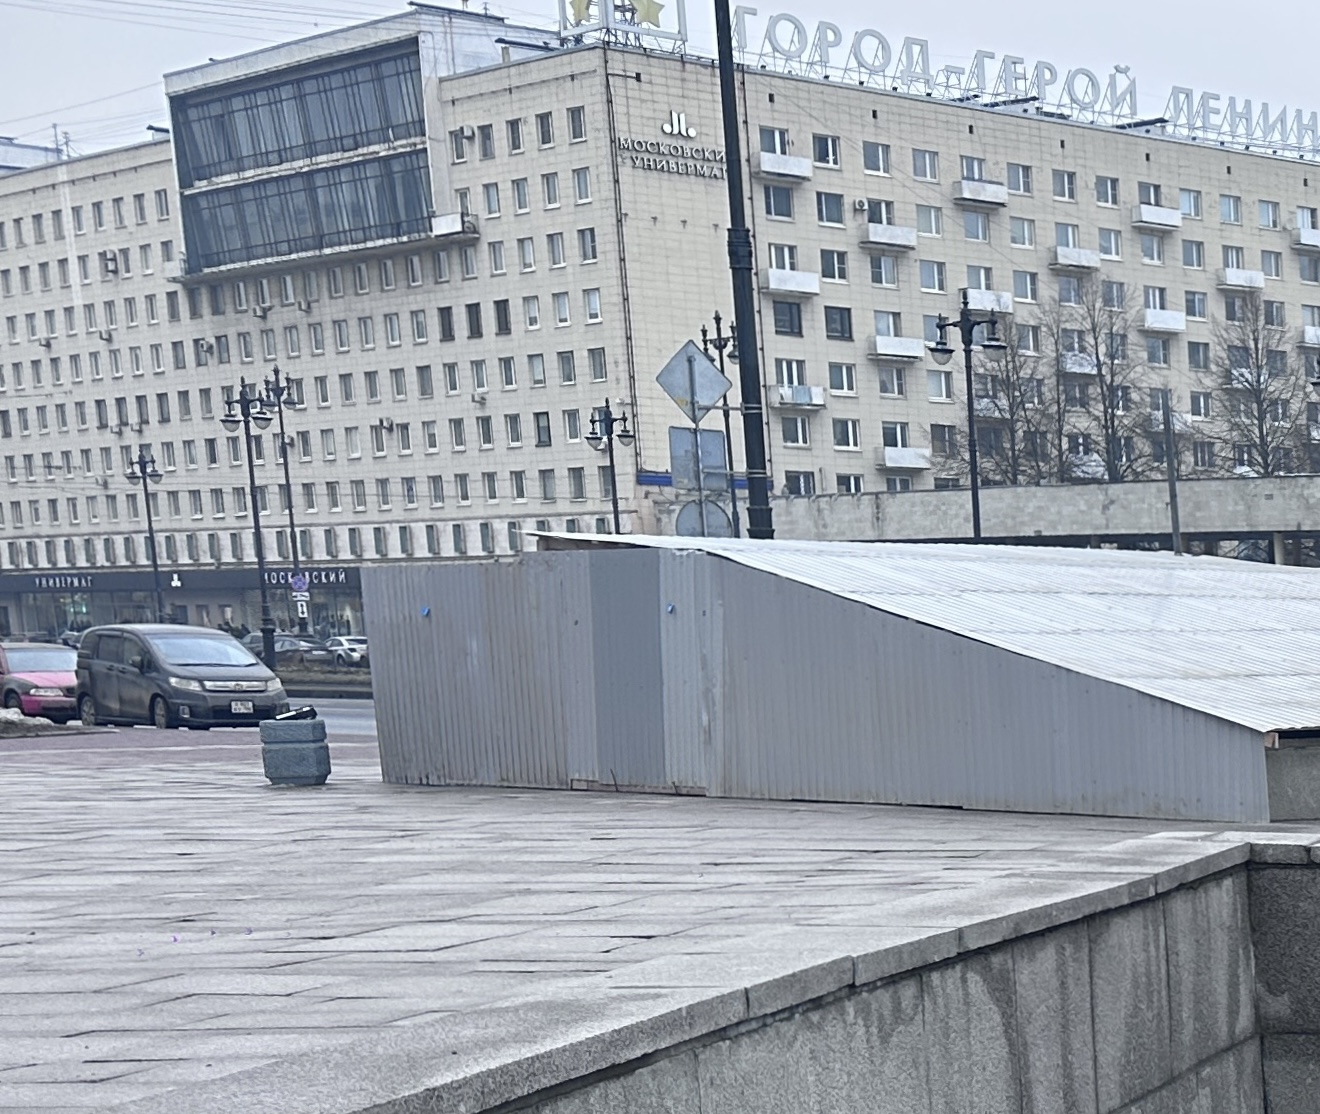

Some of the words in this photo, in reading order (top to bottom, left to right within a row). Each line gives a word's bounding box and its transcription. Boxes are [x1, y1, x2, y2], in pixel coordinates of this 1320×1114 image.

[735, 5, 1137, 117] ГОРОД-ГЕРОЙ
[618, 137, 725, 162] МОСКОВСКИ
[35, 575, 92, 588] УНИВЕРМАГ
